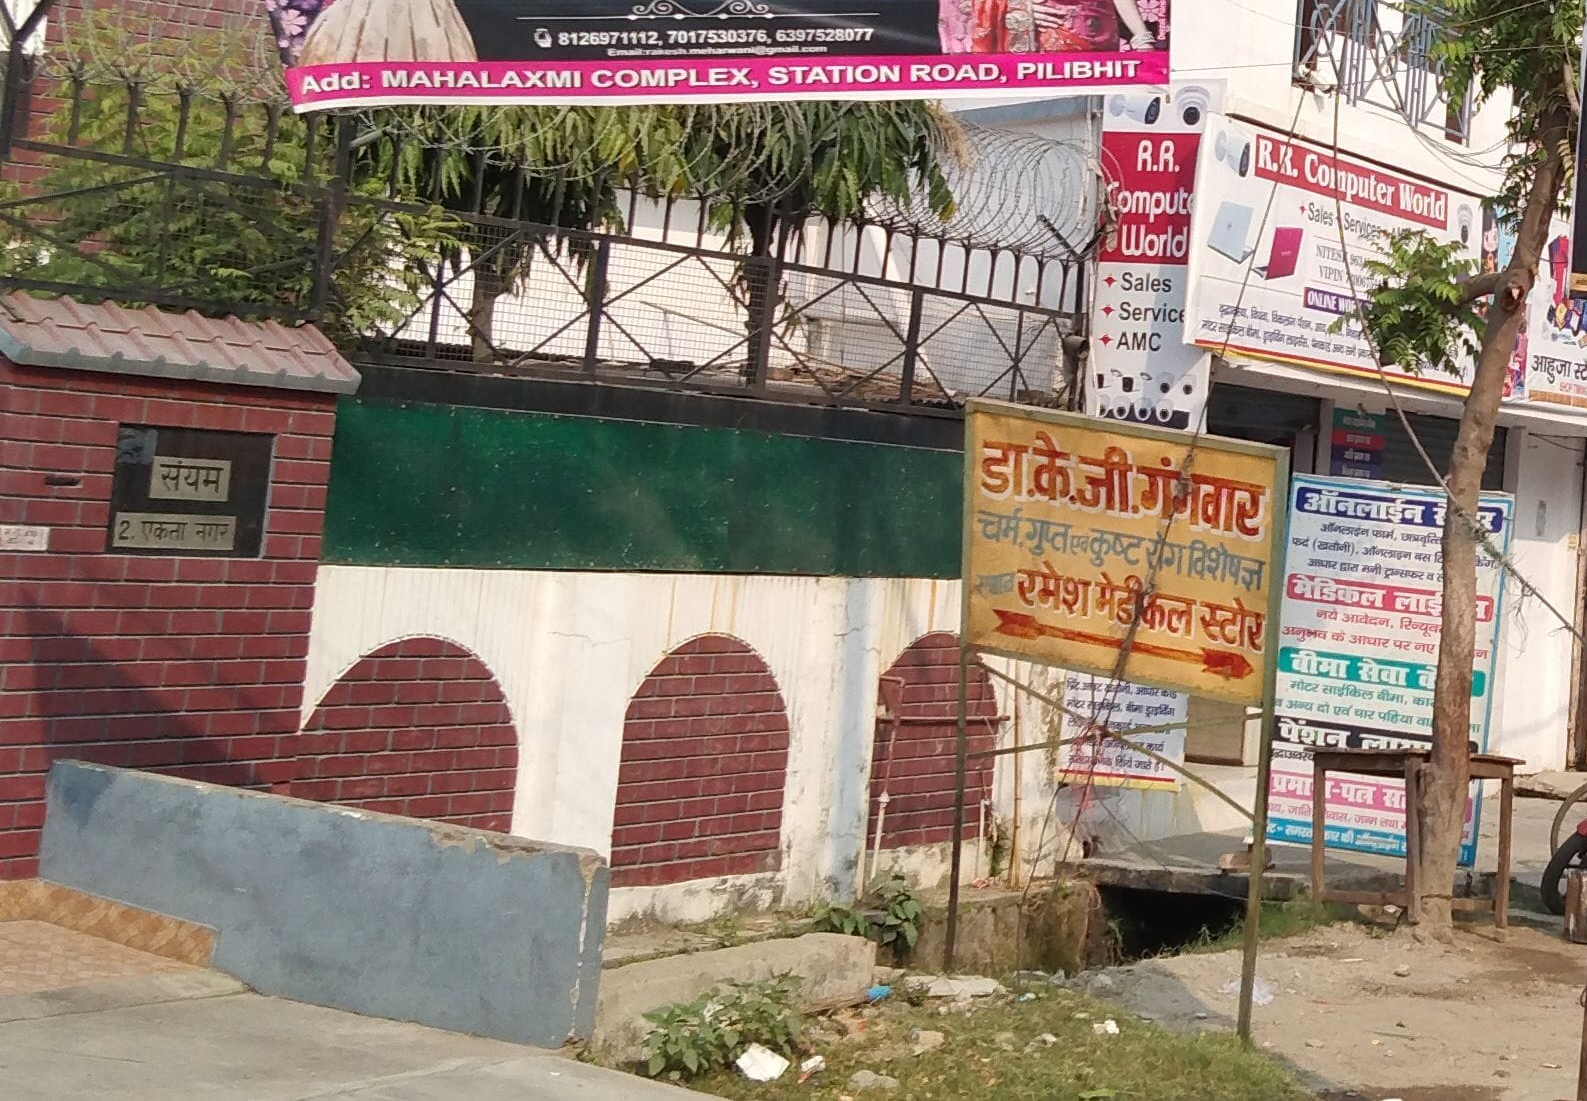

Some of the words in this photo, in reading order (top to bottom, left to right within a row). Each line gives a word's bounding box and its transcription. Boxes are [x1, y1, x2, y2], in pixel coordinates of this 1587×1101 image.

[558, 30, 663, 47] 8126971112,
[667, 29, 772, 45] 7017530376,
[775, 28, 874, 43] 6397528077
[301, 72, 371, 95] Add:
[381, 69, 582, 90] MAHALAXMI
[590, 66, 760, 90] COMPLEX,
[768, 65, 901, 85] STATION
[910, 63, 1006, 85] ROAD,
[1016, 60, 1141, 80] PILIBHIT
[1137, 139, 1180, 173] R.R.
[1304, 153, 1396, 209] Computer
[1399, 182, 1447, 222] World
[1307, 202, 1334, 227] Sales
[1122, 223, 1188, 259] World
[1120, 272, 1172, 293] Sales
[1307, 291, 1338, 311] ONLINE
[1115, 332, 1162, 352] AMC
[1531, 354, 1572, 384] आहुजा
[159, 460, 225, 493] संयम
[1303, 489, 1426, 524] ऑनलाईन
[141, 519, 189, 541] एकता
[194, 522, 230, 543] नगर
[1017, 560, 1092, 618] रमेश
[1198, 596, 1267, 651] स्टोर
[1292, 575, 1387, 608] मेडिकल
[1281, 625, 1328, 642] अनुभव
[1331, 630, 1347, 643] के
[1349, 632, 1390, 648] आधार
[1393, 638, 1413, 651] पर
[1414, 641, 1436, 655] नए
[1290, 650, 1351, 679] बीमा
[1358, 658, 1410, 686] सेवा
[1290, 679, 1319, 693] मोटर
[1285, 700, 1314, 711] अन्य
[1316, 700, 1330, 714] दो
[1332, 703, 1352, 717] एवं
[1354, 707, 1375, 720] चार
[1378, 708, 1413, 726] पहिया
[1278, 716, 1351, 749] पेंशन
